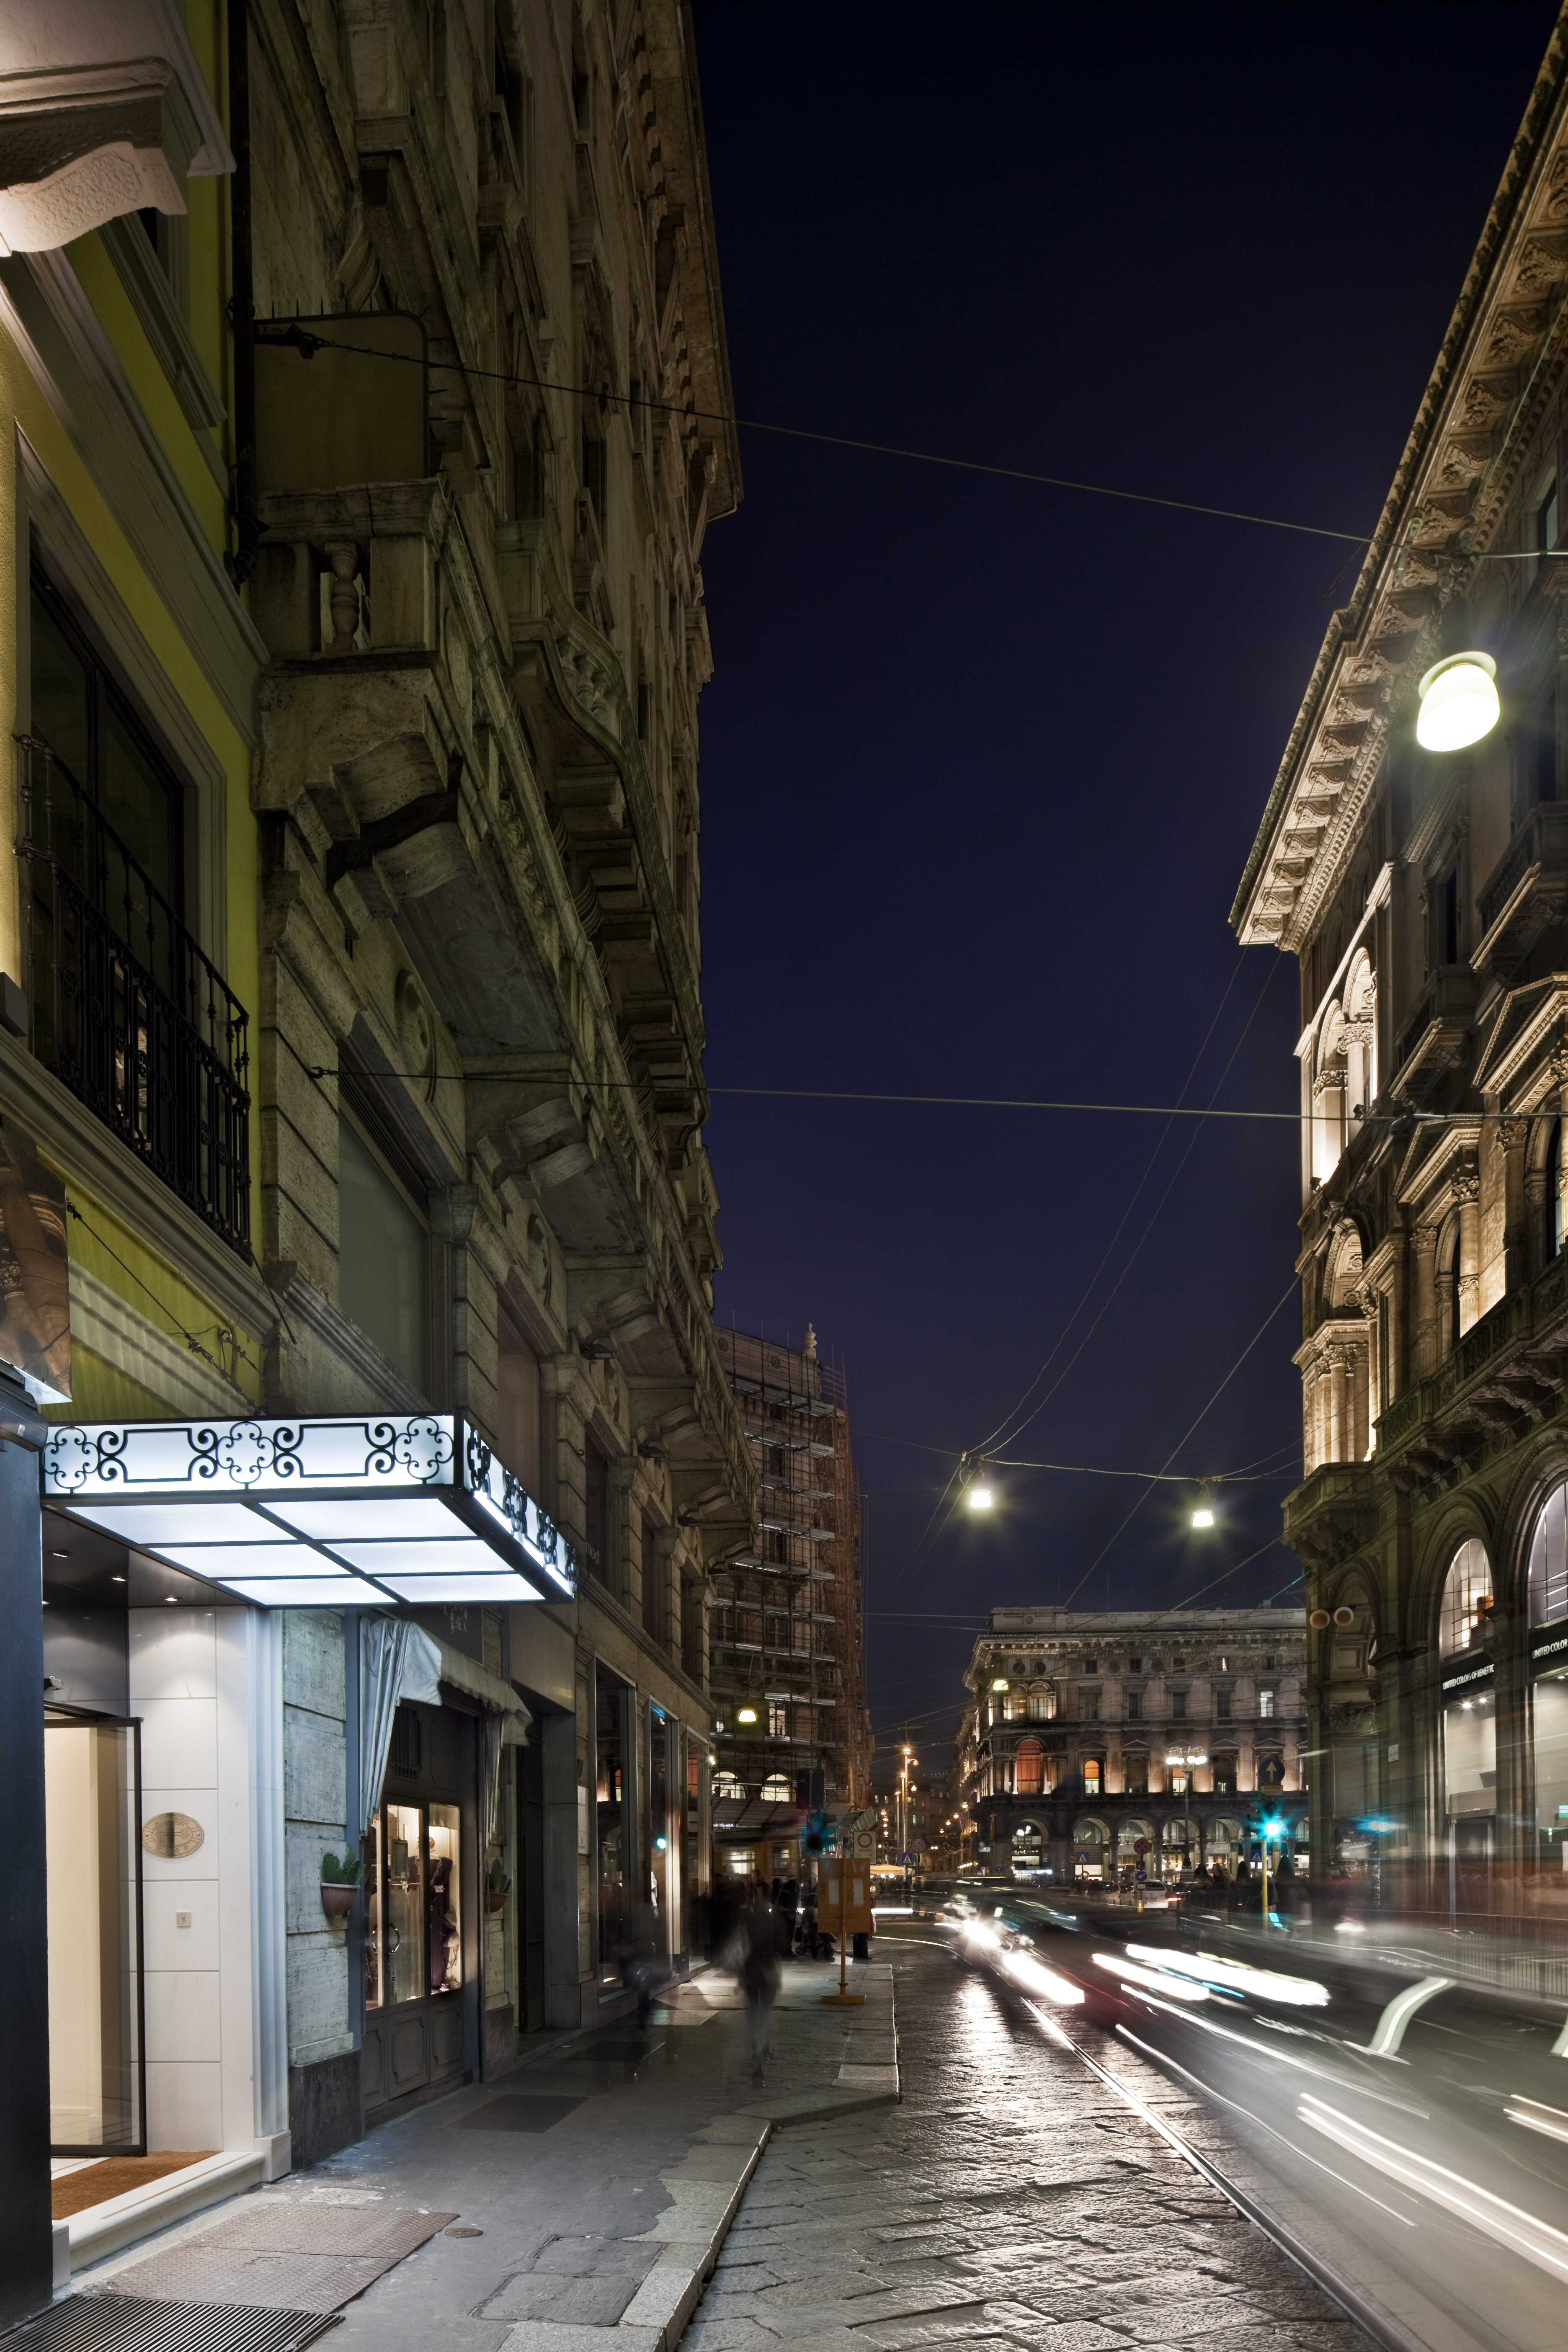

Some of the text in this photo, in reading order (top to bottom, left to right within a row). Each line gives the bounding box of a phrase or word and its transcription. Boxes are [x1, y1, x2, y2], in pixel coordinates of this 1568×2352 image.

[1532, 1638, 1568, 1659] UNITED COLOR
[1443, 1678, 1457, 1690] UNITED
[1456, 1673, 1471, 1685] COLORS
[1471, 1671, 1477, 1680] OF
[155, 1816, 190, 1826] ALBERGO
